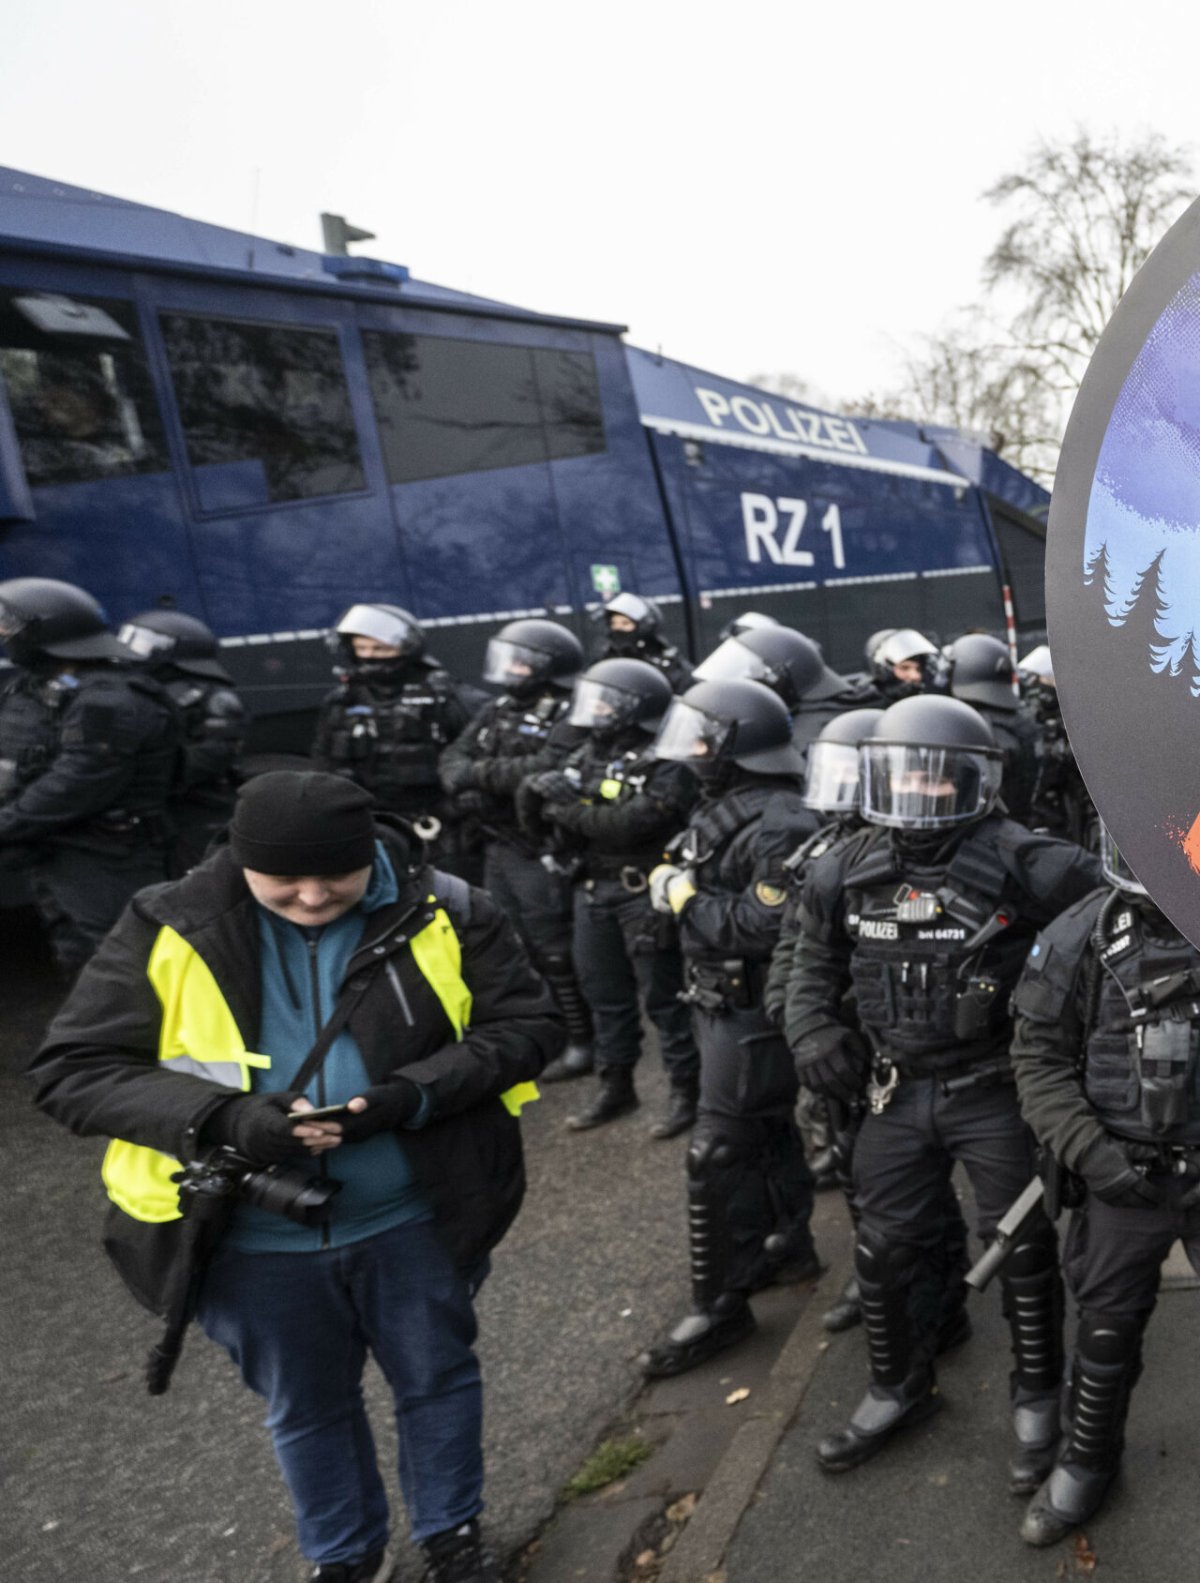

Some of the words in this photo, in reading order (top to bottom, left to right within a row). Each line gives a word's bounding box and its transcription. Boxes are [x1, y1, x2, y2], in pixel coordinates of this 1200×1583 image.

[695, 387, 869, 455] POLIZEI
[740, 491, 815, 567] RZ
[822, 503, 846, 569] 1
[859, 920, 898, 939] POLIZEI
